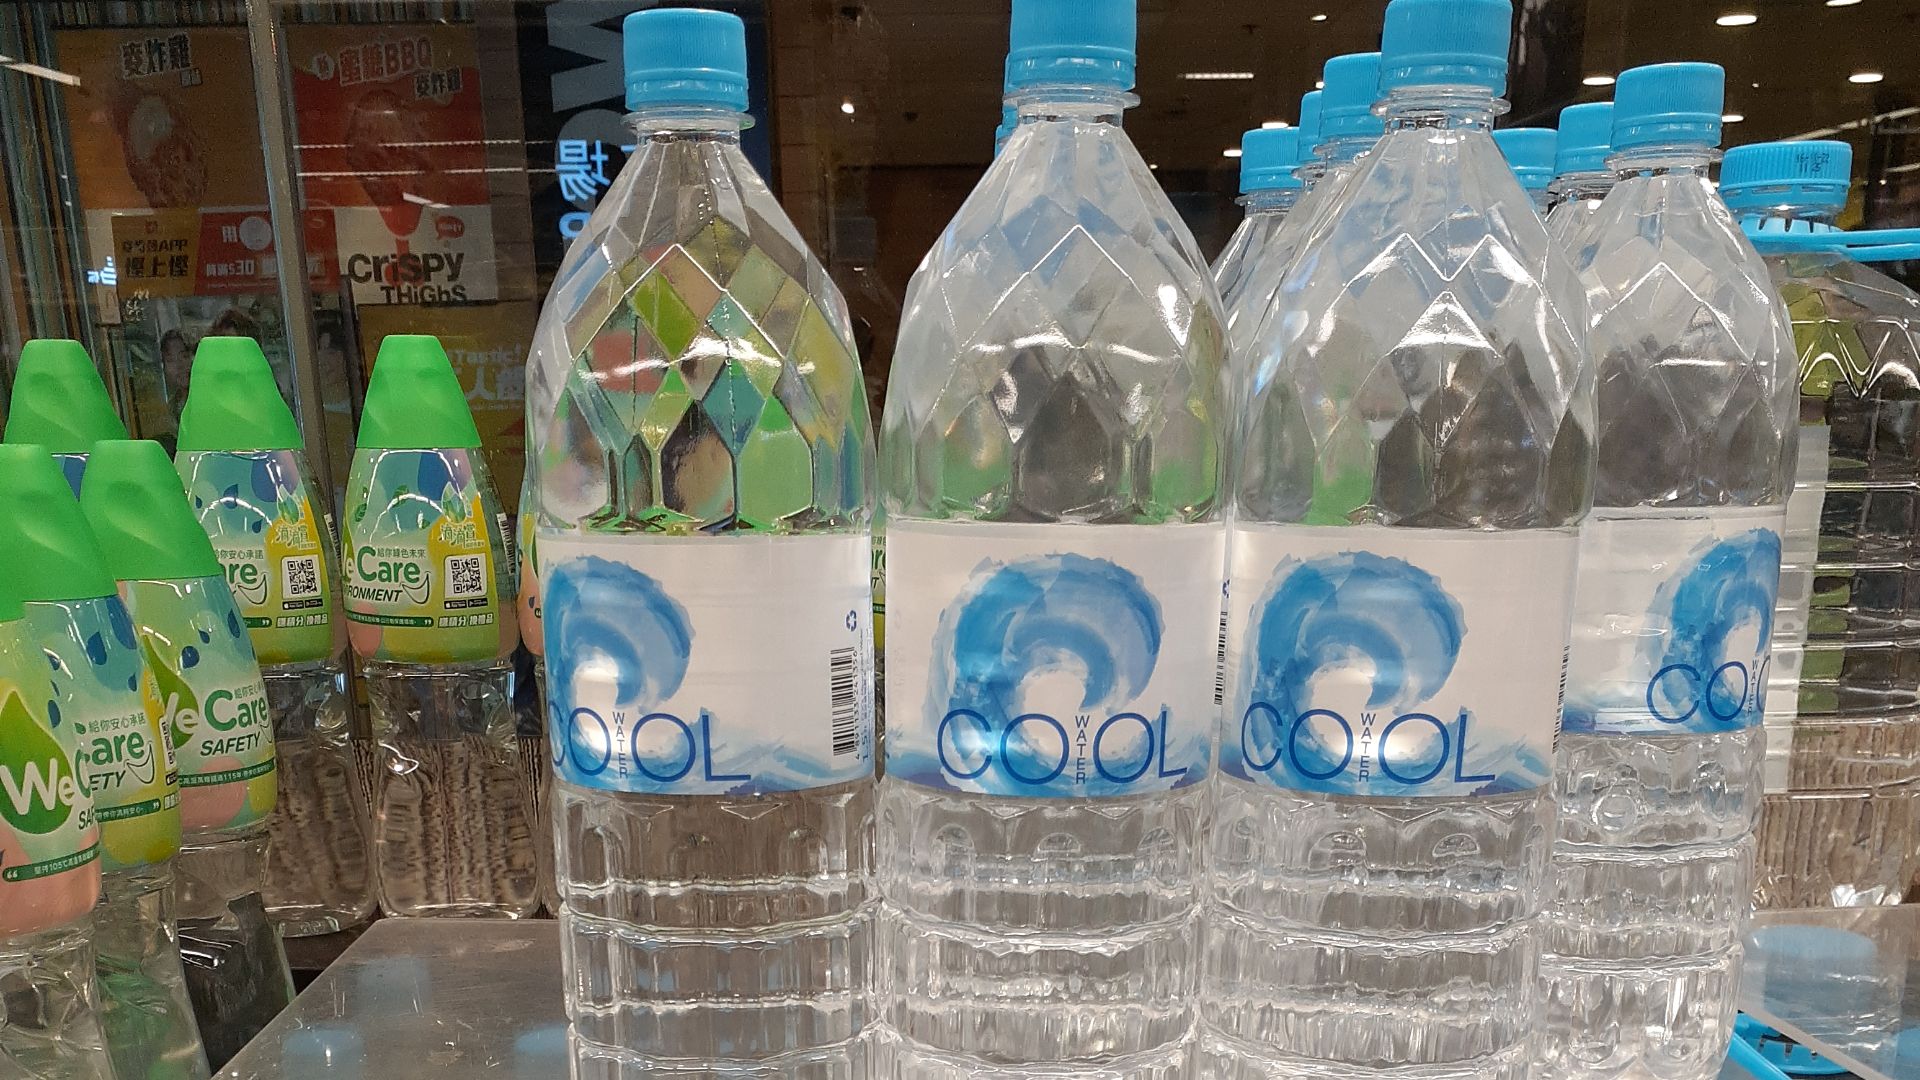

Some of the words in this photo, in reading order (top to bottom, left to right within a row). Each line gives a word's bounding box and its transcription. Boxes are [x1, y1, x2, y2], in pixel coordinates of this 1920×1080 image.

[357, 546, 420, 584] Care
[200, 731, 261, 757] SAFETY
[612, 711, 629, 779] WATER
[937, 708, 1188, 785] COOL
[1074, 714, 1091, 785] WATER
[1241, 702, 1496, 785] COOL
[1358, 712, 1377, 782] WATER
